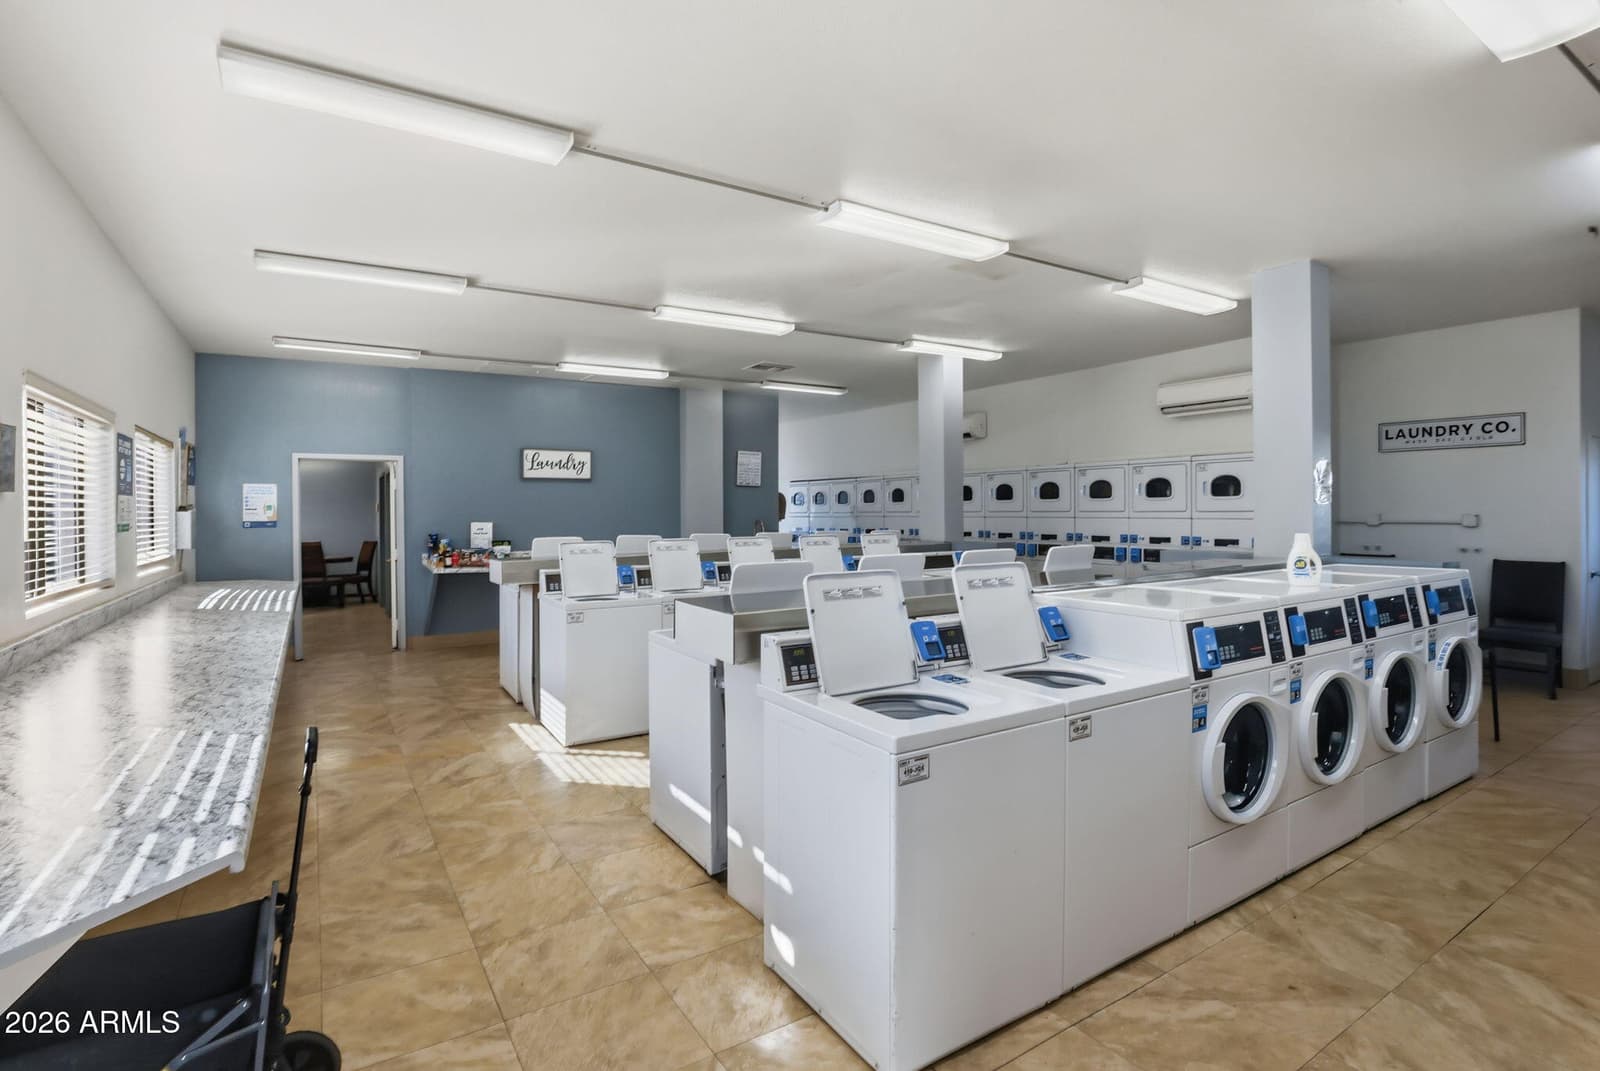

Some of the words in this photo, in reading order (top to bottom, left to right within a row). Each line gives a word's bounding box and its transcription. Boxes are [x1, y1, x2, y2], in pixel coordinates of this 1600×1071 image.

[1385, 423, 1473, 440] LAUNDRY
[1481, 421, 1517, 434] CO.
[525, 451, 588, 476] Laundry
